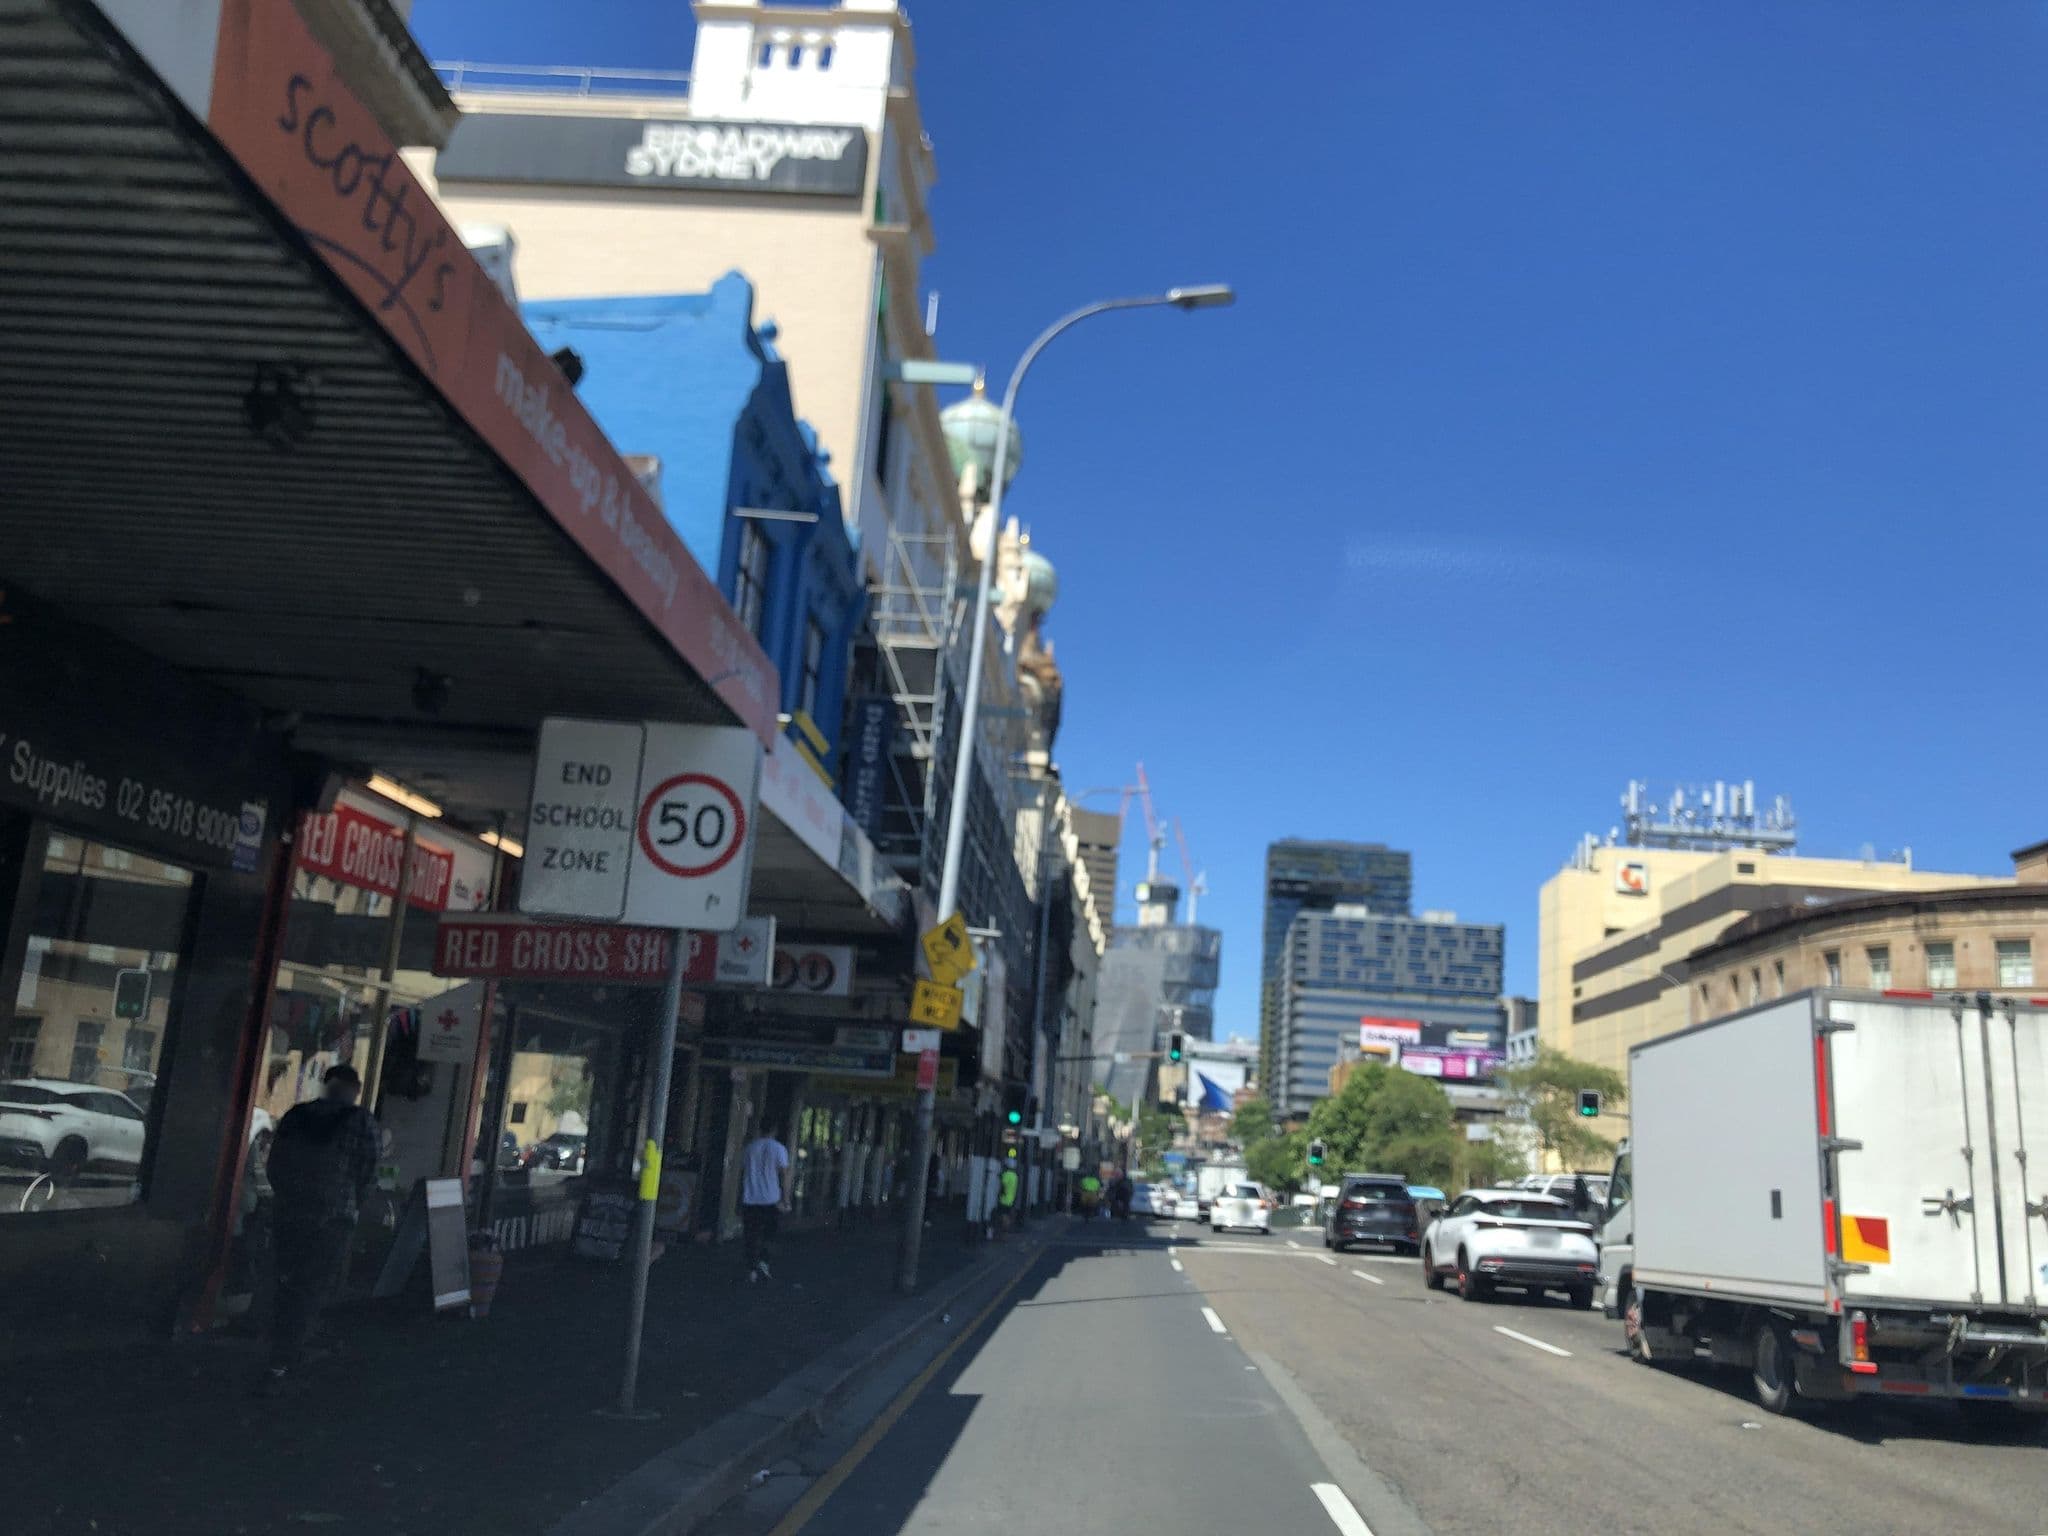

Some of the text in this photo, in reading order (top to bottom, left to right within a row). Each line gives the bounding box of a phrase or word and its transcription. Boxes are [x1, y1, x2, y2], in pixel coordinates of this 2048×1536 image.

[643, 124, 852, 160] BROADWAY
[626, 146, 783, 179] SYDNEY
[9, 739, 108, 810] Supplies
[117, 776, 145, 822] 02
[147, 788, 195, 838] 9518
[561, 760, 613, 787] END
[532, 801, 628, 832] SCHOOL
[656, 802, 727, 850] 50
[341, 820, 404, 890] CROSS
[541, 846, 610, 874] ZONE
[443, 927, 703, 973] RED CROSS SHP
